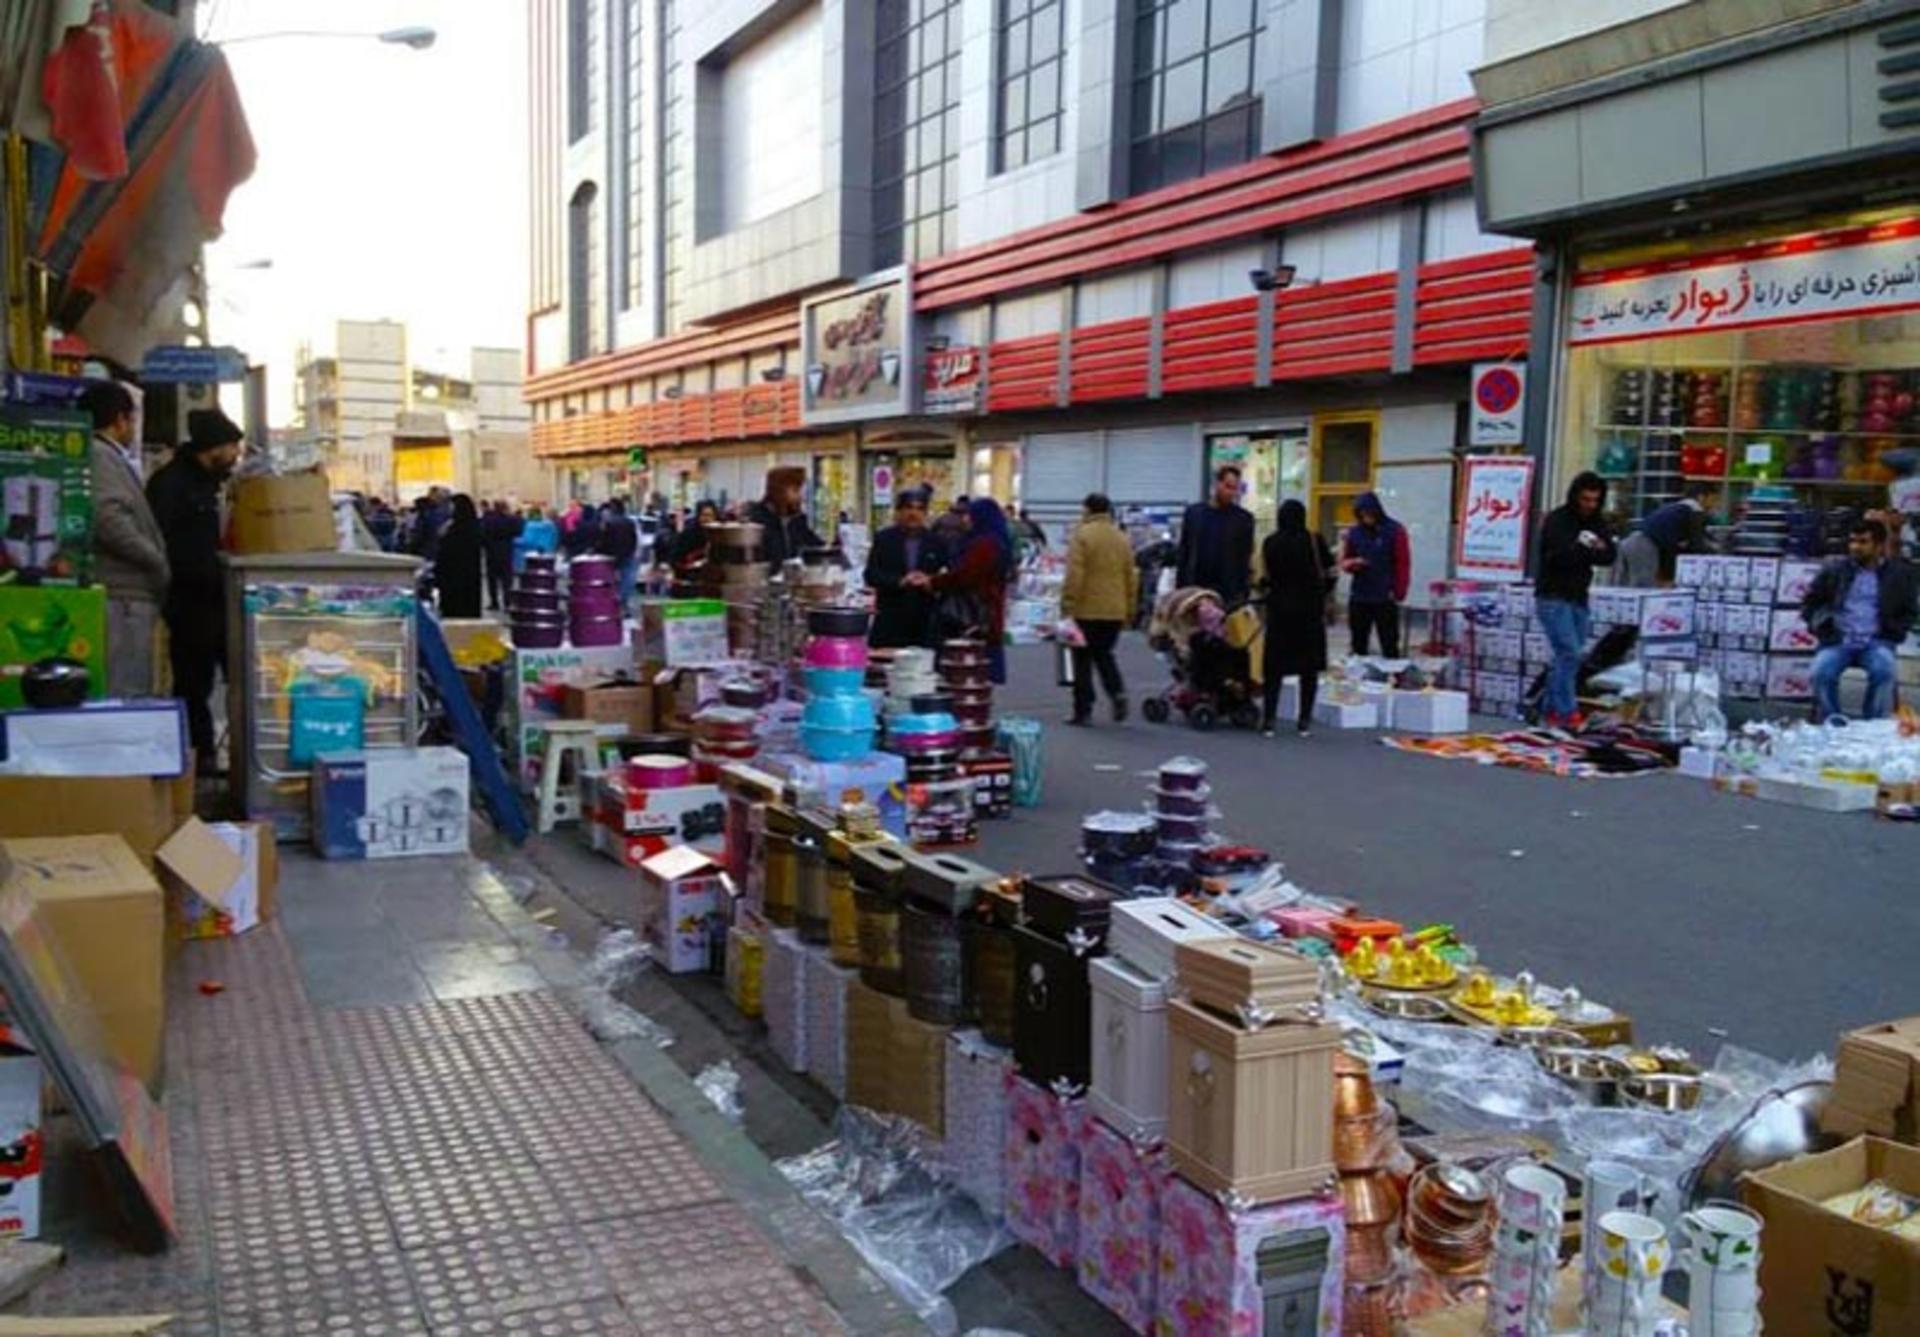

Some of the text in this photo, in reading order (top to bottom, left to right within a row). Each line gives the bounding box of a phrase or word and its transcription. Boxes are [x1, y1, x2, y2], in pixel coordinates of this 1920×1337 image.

[1668, 267, 1751, 323] ژیوار
[1769, 281, 1784, 308] را
[1787, 277, 1808, 304] ای
[1812, 271, 1855, 301] حرفه
